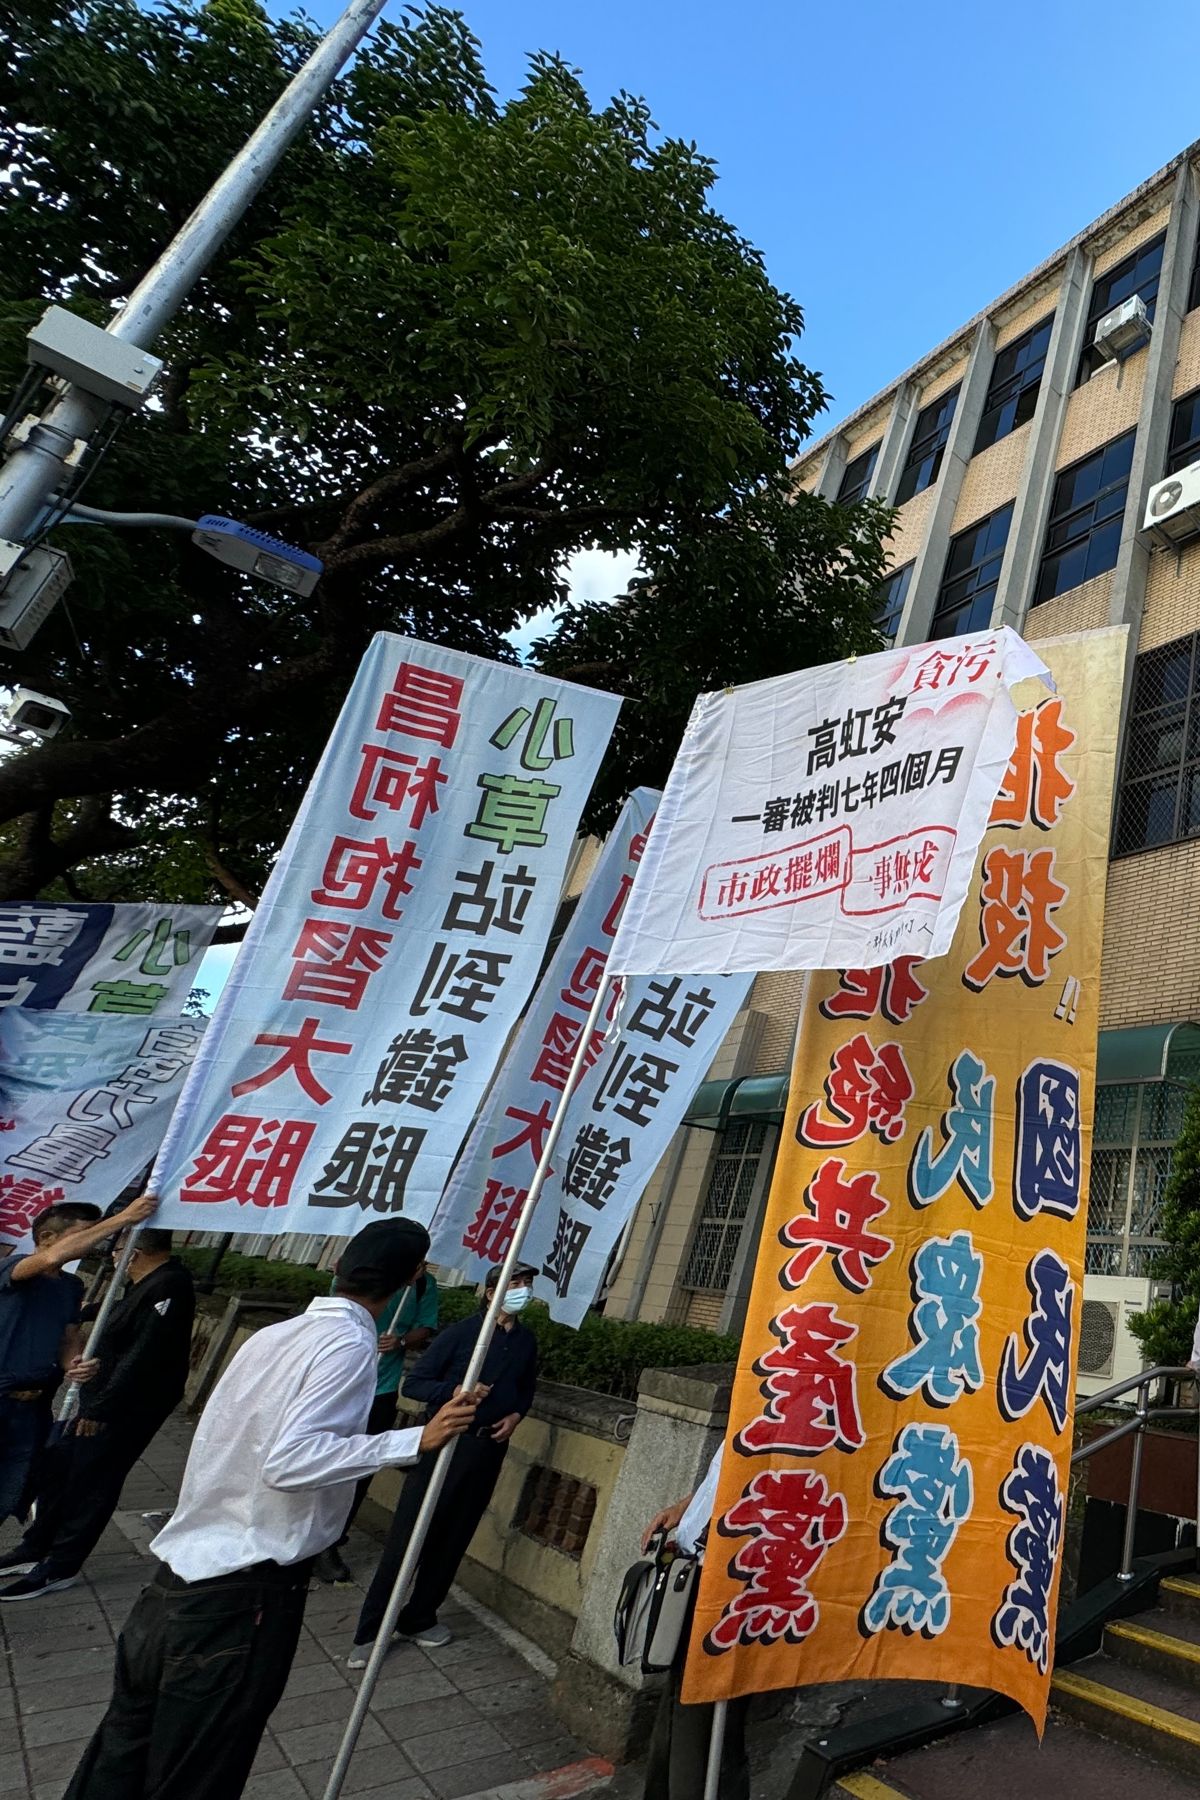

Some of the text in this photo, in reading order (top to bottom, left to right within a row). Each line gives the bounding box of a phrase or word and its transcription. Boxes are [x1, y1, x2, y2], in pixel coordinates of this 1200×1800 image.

[806, 695, 908, 776] 高虹安
[731, 746, 964, 833] 一審被判七年四個月
[717, 840, 841, 907] 市政擺爛
